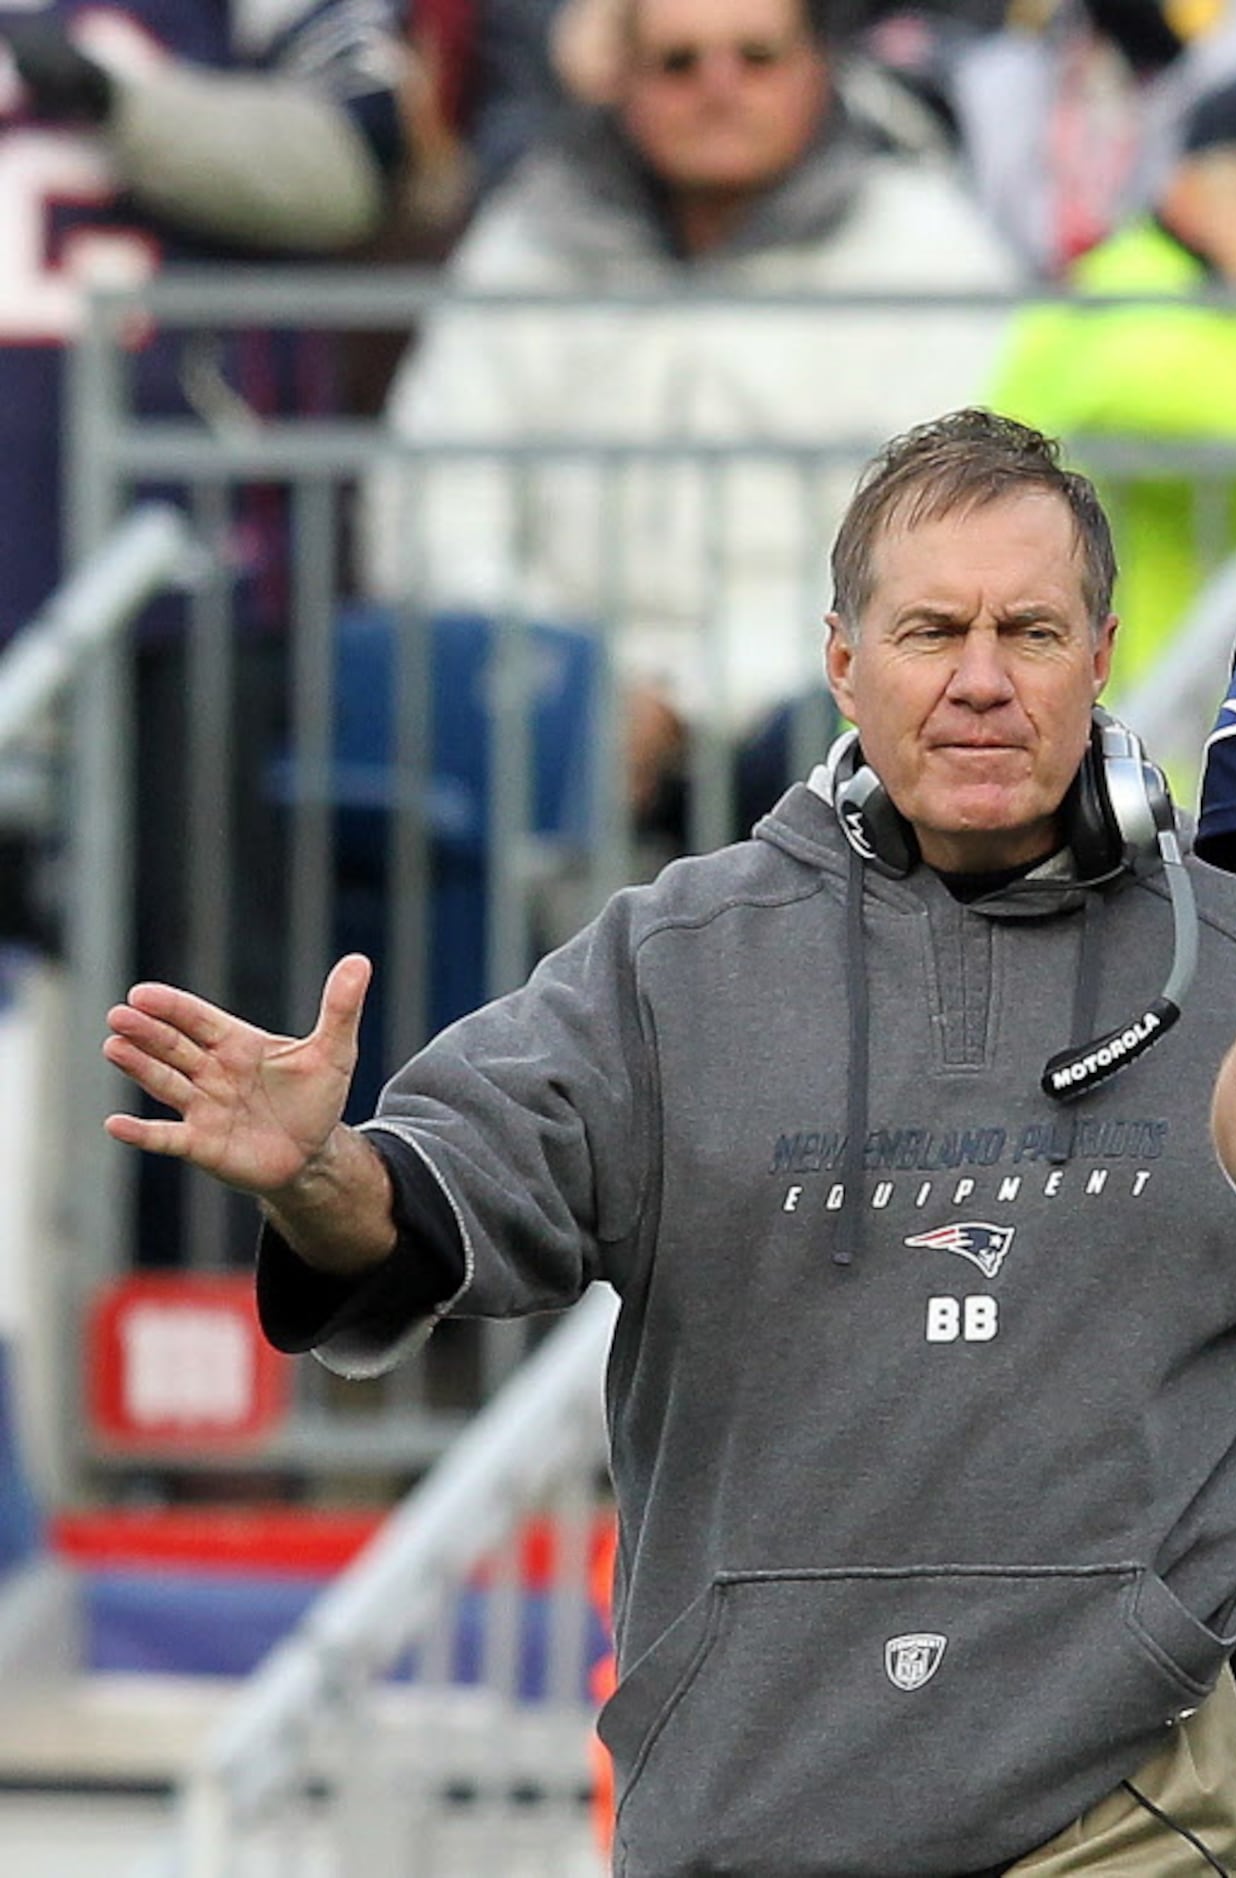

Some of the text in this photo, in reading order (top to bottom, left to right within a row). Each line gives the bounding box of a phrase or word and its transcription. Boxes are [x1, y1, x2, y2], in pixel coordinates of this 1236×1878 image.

[1051, 1012, 1161, 1090] MOTOROLA
[769, 1121, 1169, 1175] NEW ENGLAND PARIOTS
[783, 1170, 1151, 1212] EQUIPMENT
[926, 1295, 999, 1342] BB
